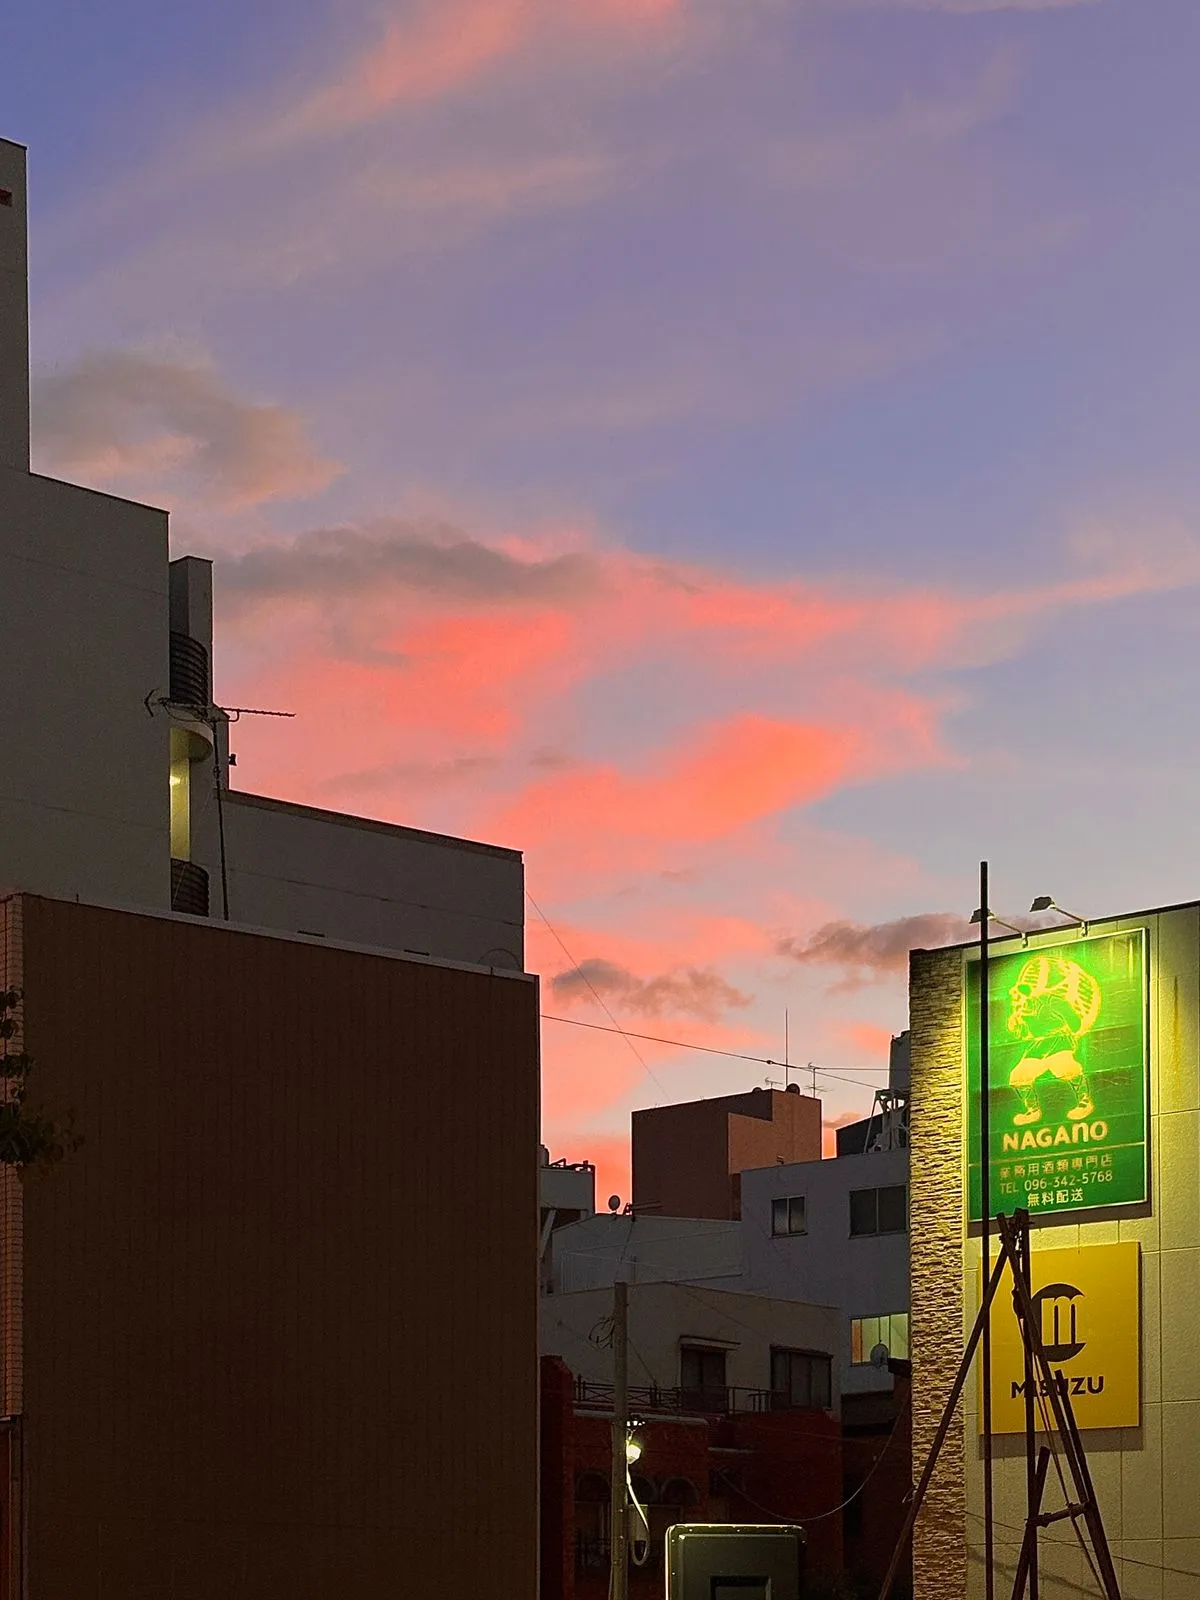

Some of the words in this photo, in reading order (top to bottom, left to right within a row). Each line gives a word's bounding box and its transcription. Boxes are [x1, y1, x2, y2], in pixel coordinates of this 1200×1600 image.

[1000, 1182, 1019, 1194] TEL
[1024, 1169, 1113, 1192] 096-342-5768
[1027, 1187, 1084, 1207] 無料配送
